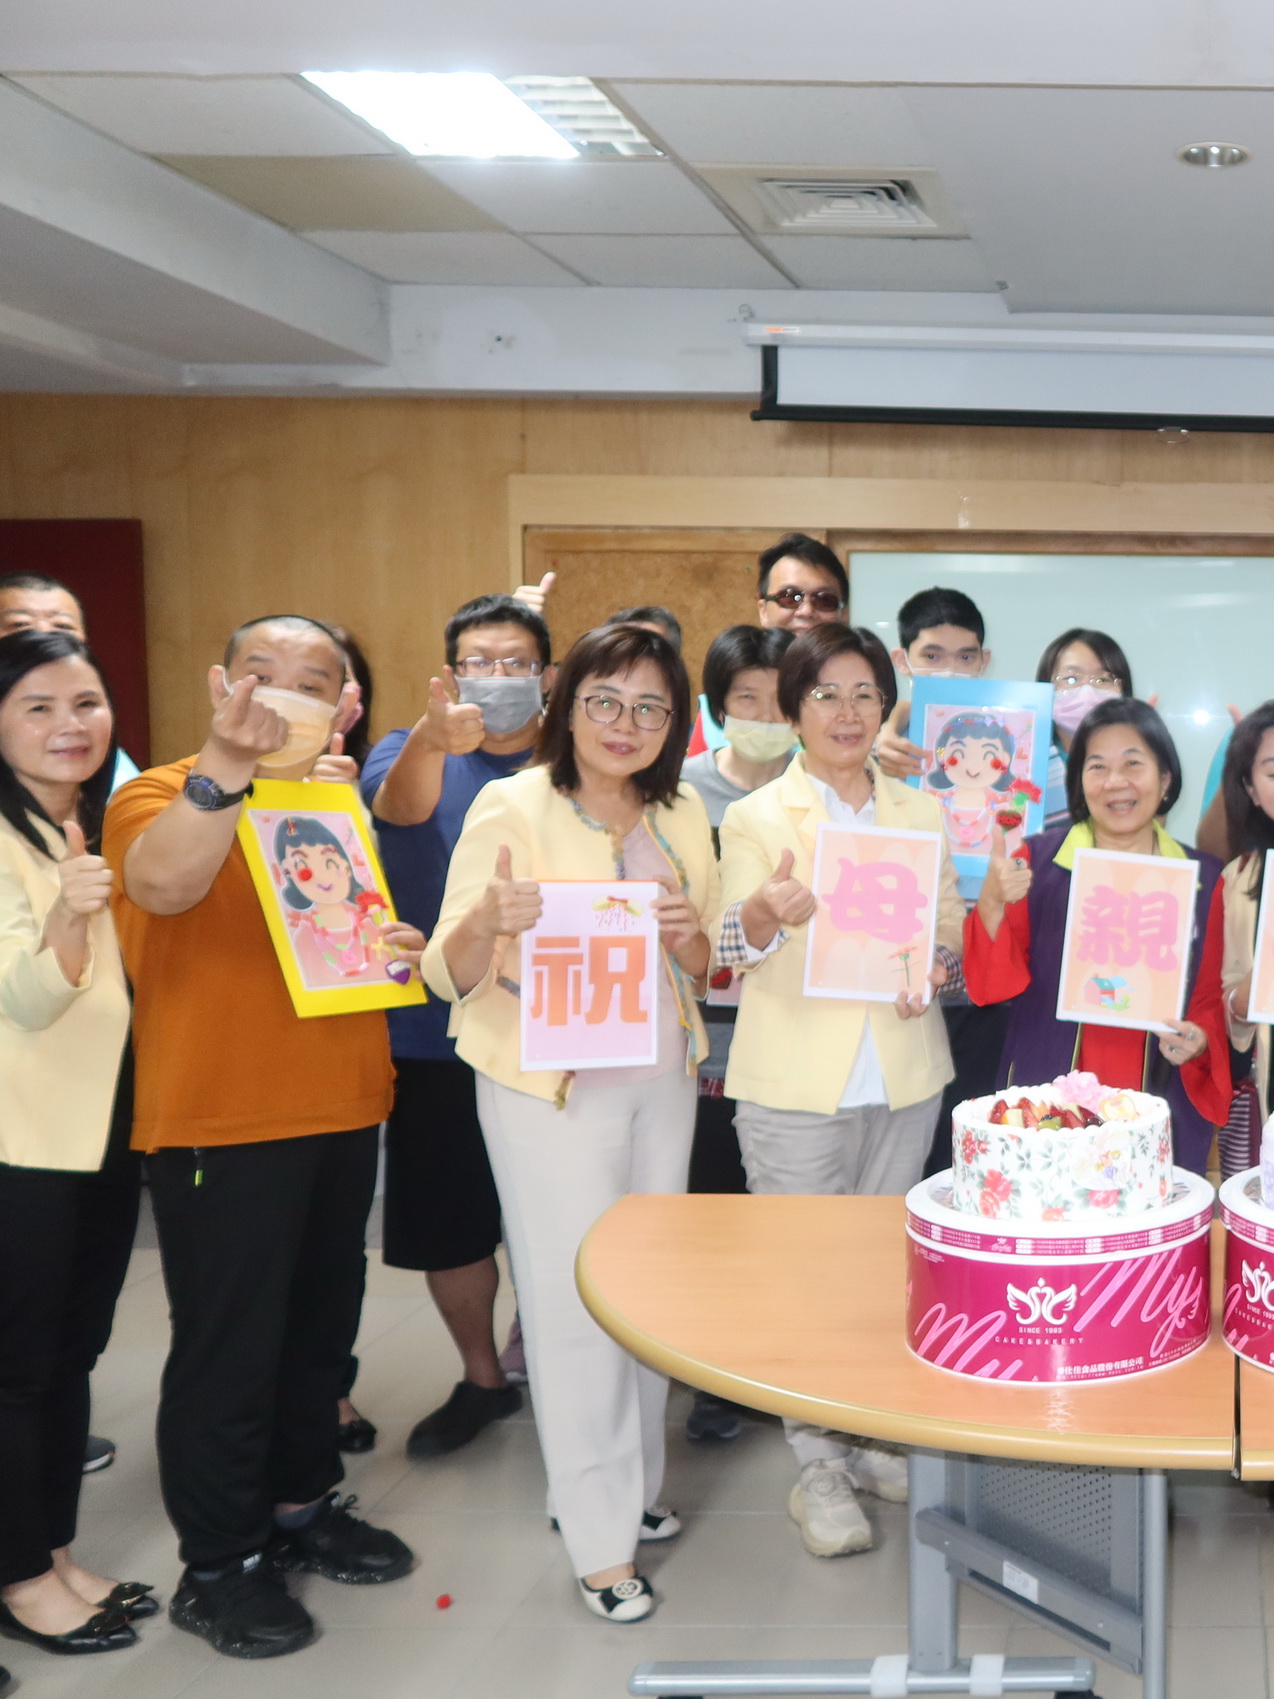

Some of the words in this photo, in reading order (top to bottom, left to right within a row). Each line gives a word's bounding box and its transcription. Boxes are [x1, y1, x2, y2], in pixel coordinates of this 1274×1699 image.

[821, 857, 928, 944] 母
[1076, 884, 1178, 972] 親
[530, 935, 648, 1026] 祝
